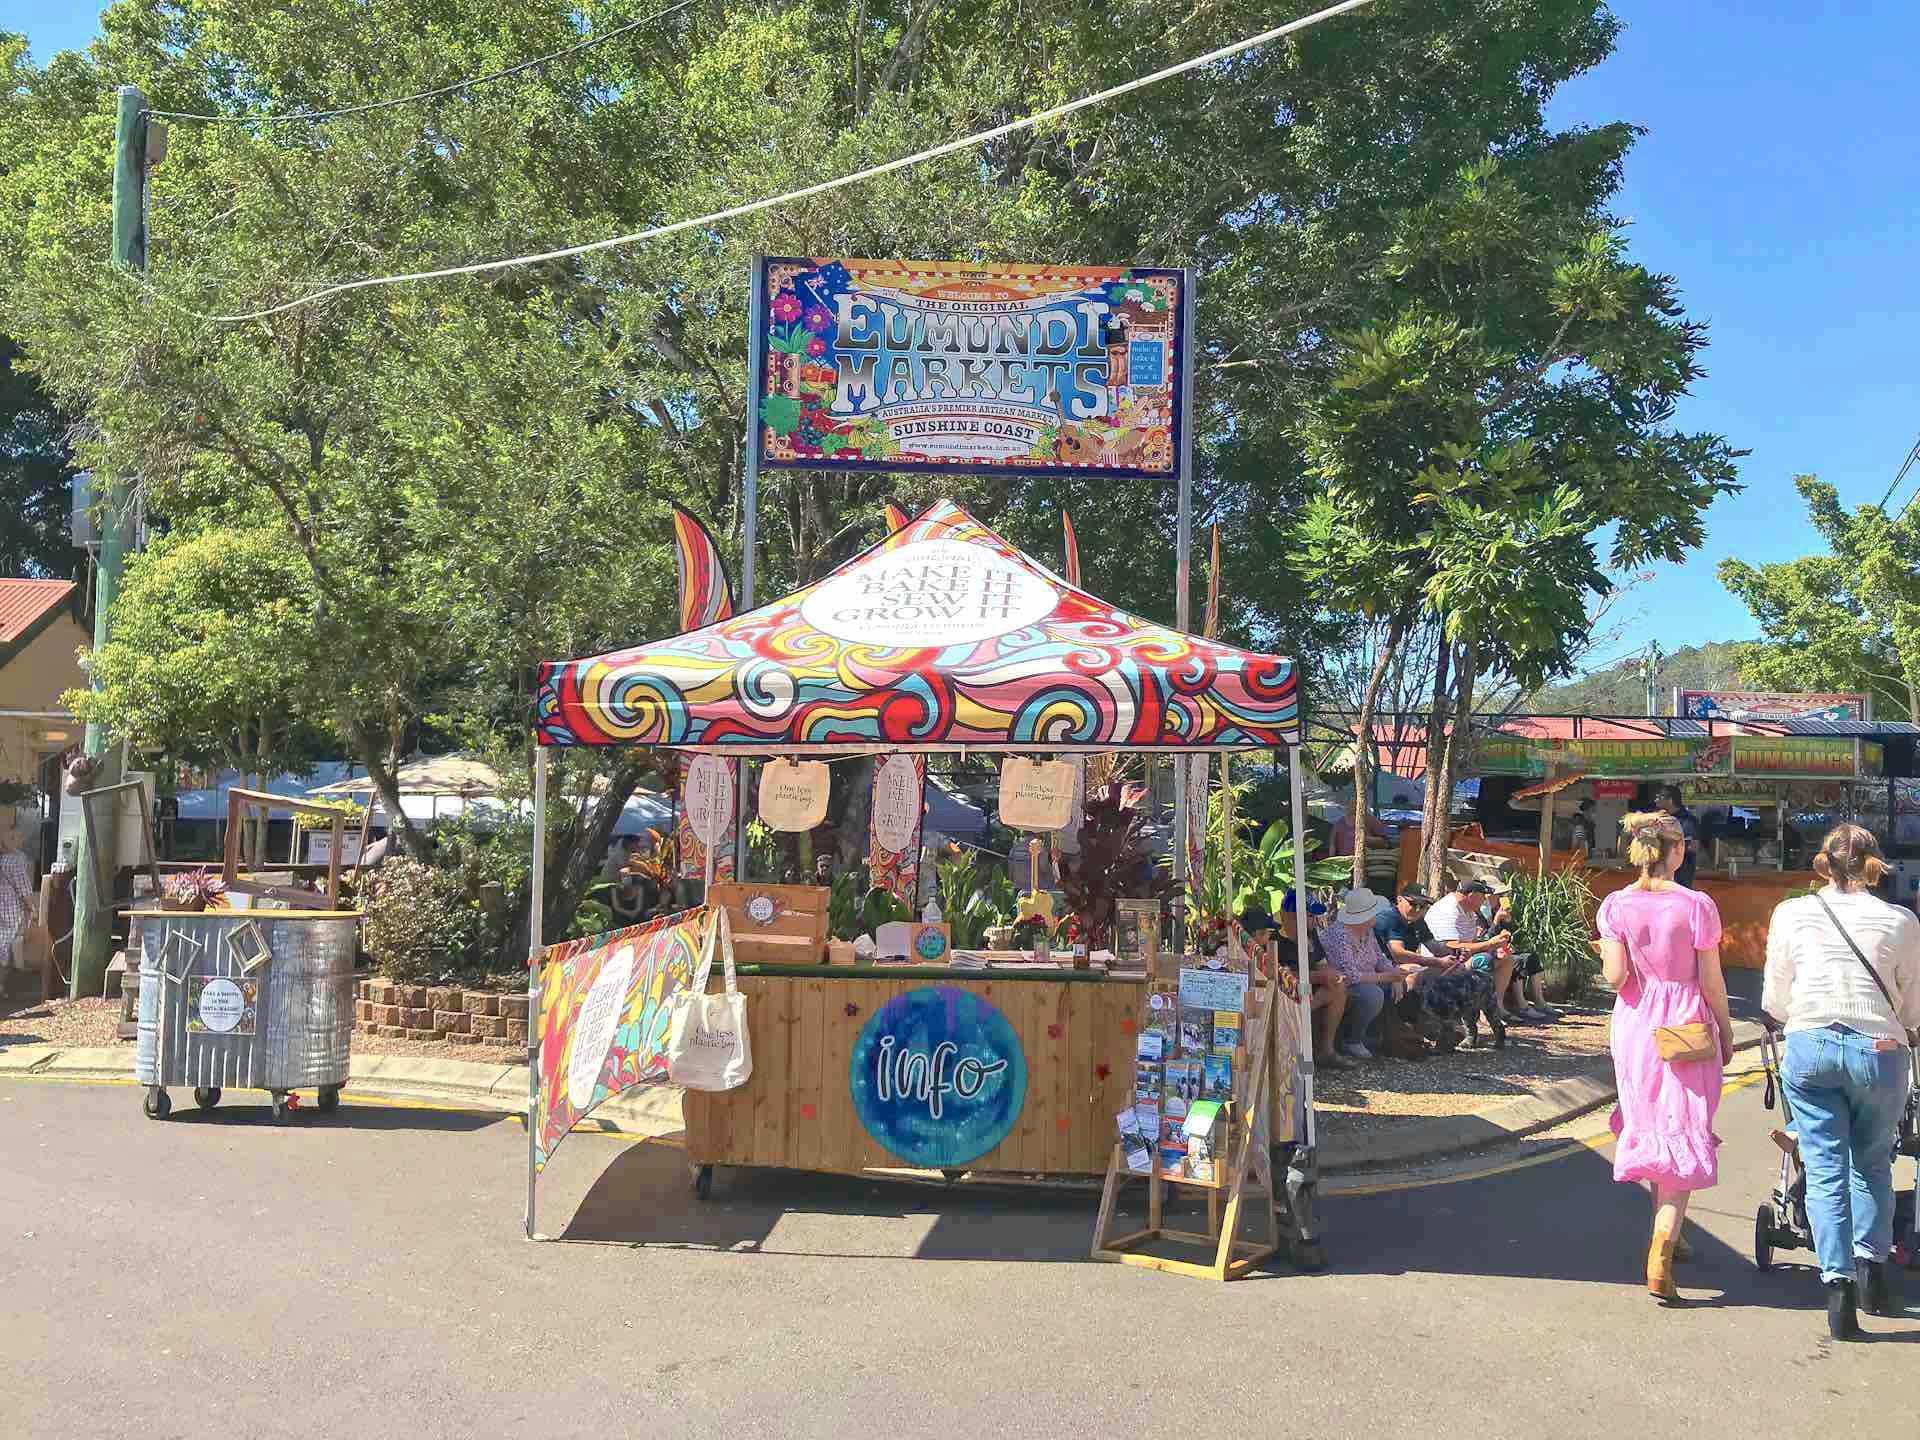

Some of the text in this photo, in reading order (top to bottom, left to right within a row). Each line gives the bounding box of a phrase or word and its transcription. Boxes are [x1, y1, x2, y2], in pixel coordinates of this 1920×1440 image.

[915, 299, 1029, 312] THE ORIGINAL
[833, 293, 1110, 359] EUMUNDI
[830, 354, 1109, 418] MARKETS
[882, 405, 937, 418] AUSTRALIA'S
[938, 404, 978, 413] PREMIER
[979, 405, 1017, 416] ARTISAN
[894, 420, 1034, 440] SUNSHINE COAST
[858, 565, 973, 582] MAKE
[862, 579, 969, 595] BAKE
[881, 592, 969, 607] SEW
[831, 605, 1021, 623] GROW IT
[877, 1035, 1008, 1120] info
